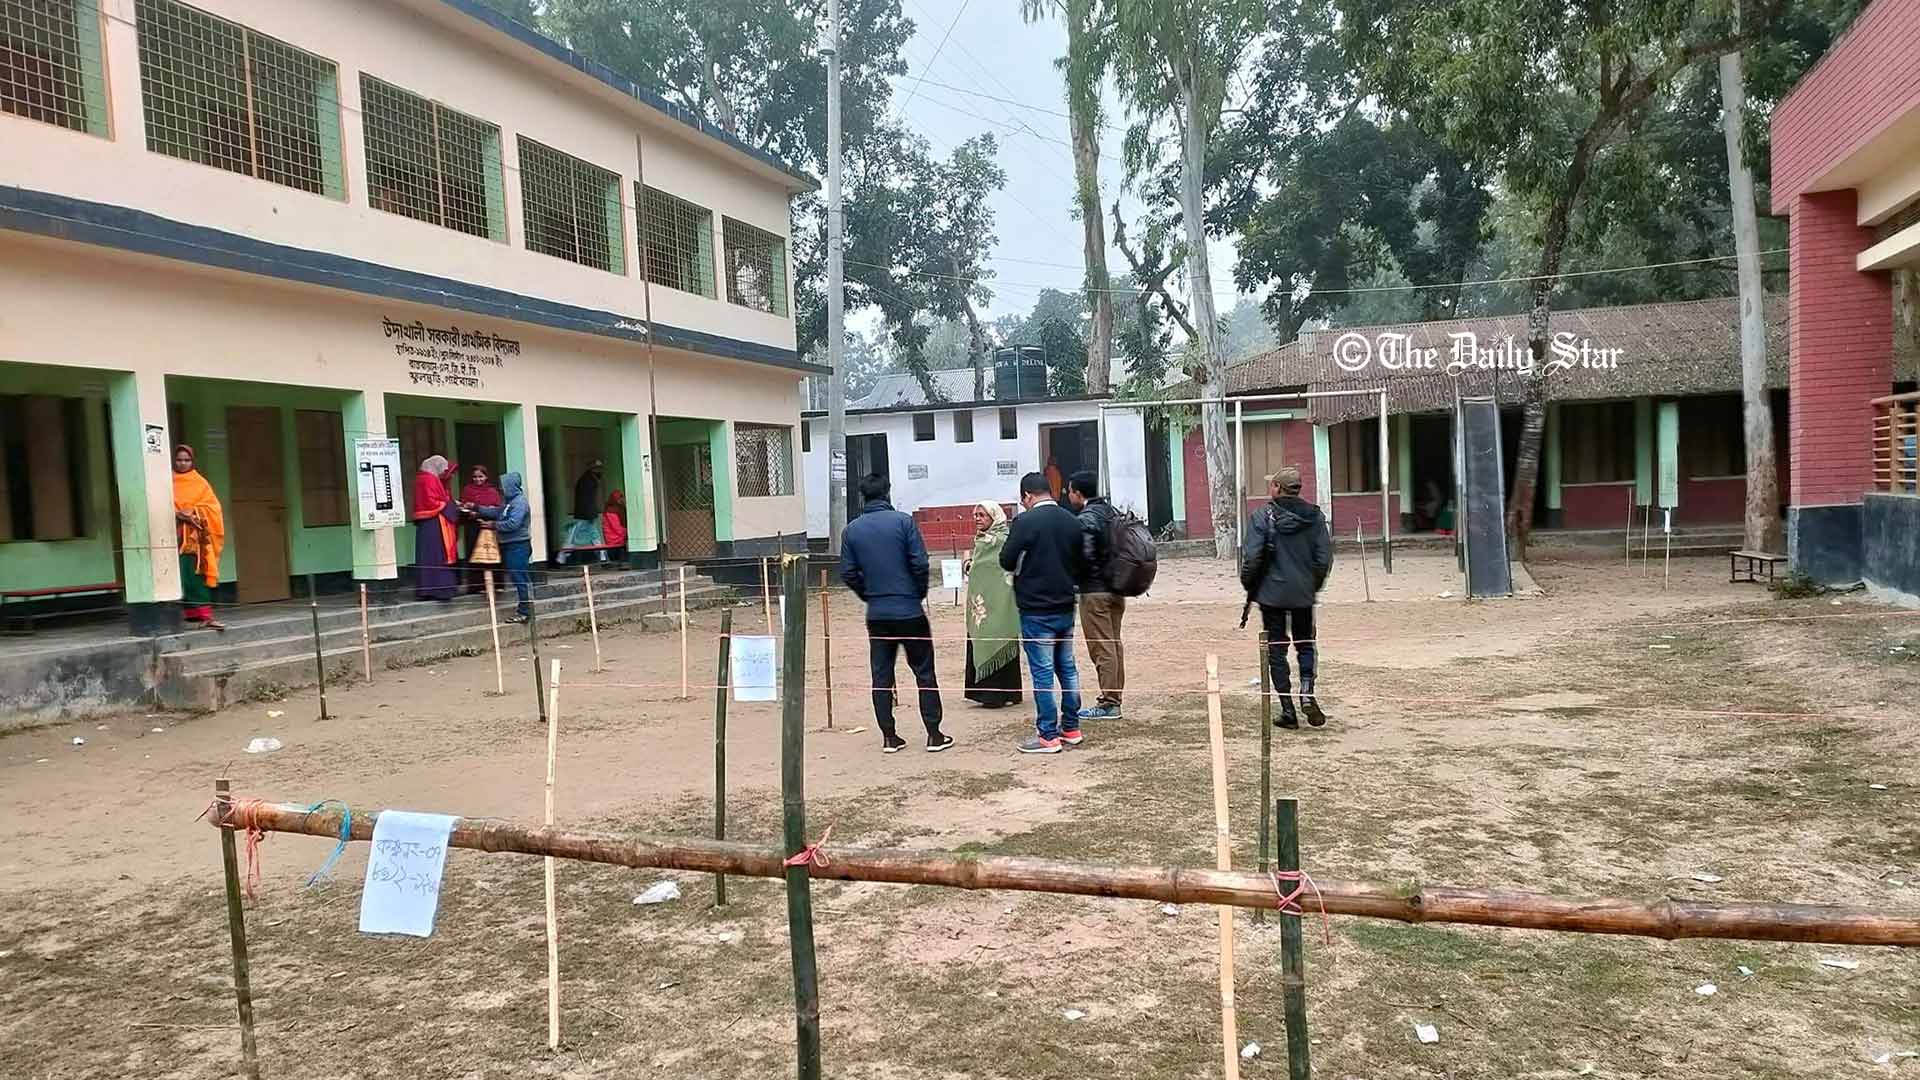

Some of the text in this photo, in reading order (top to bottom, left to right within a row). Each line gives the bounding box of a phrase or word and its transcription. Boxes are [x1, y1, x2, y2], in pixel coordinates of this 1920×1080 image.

[382, 315, 520, 356] উদাখালী সরকারী প্রাথমিক বিদ্যালয়
